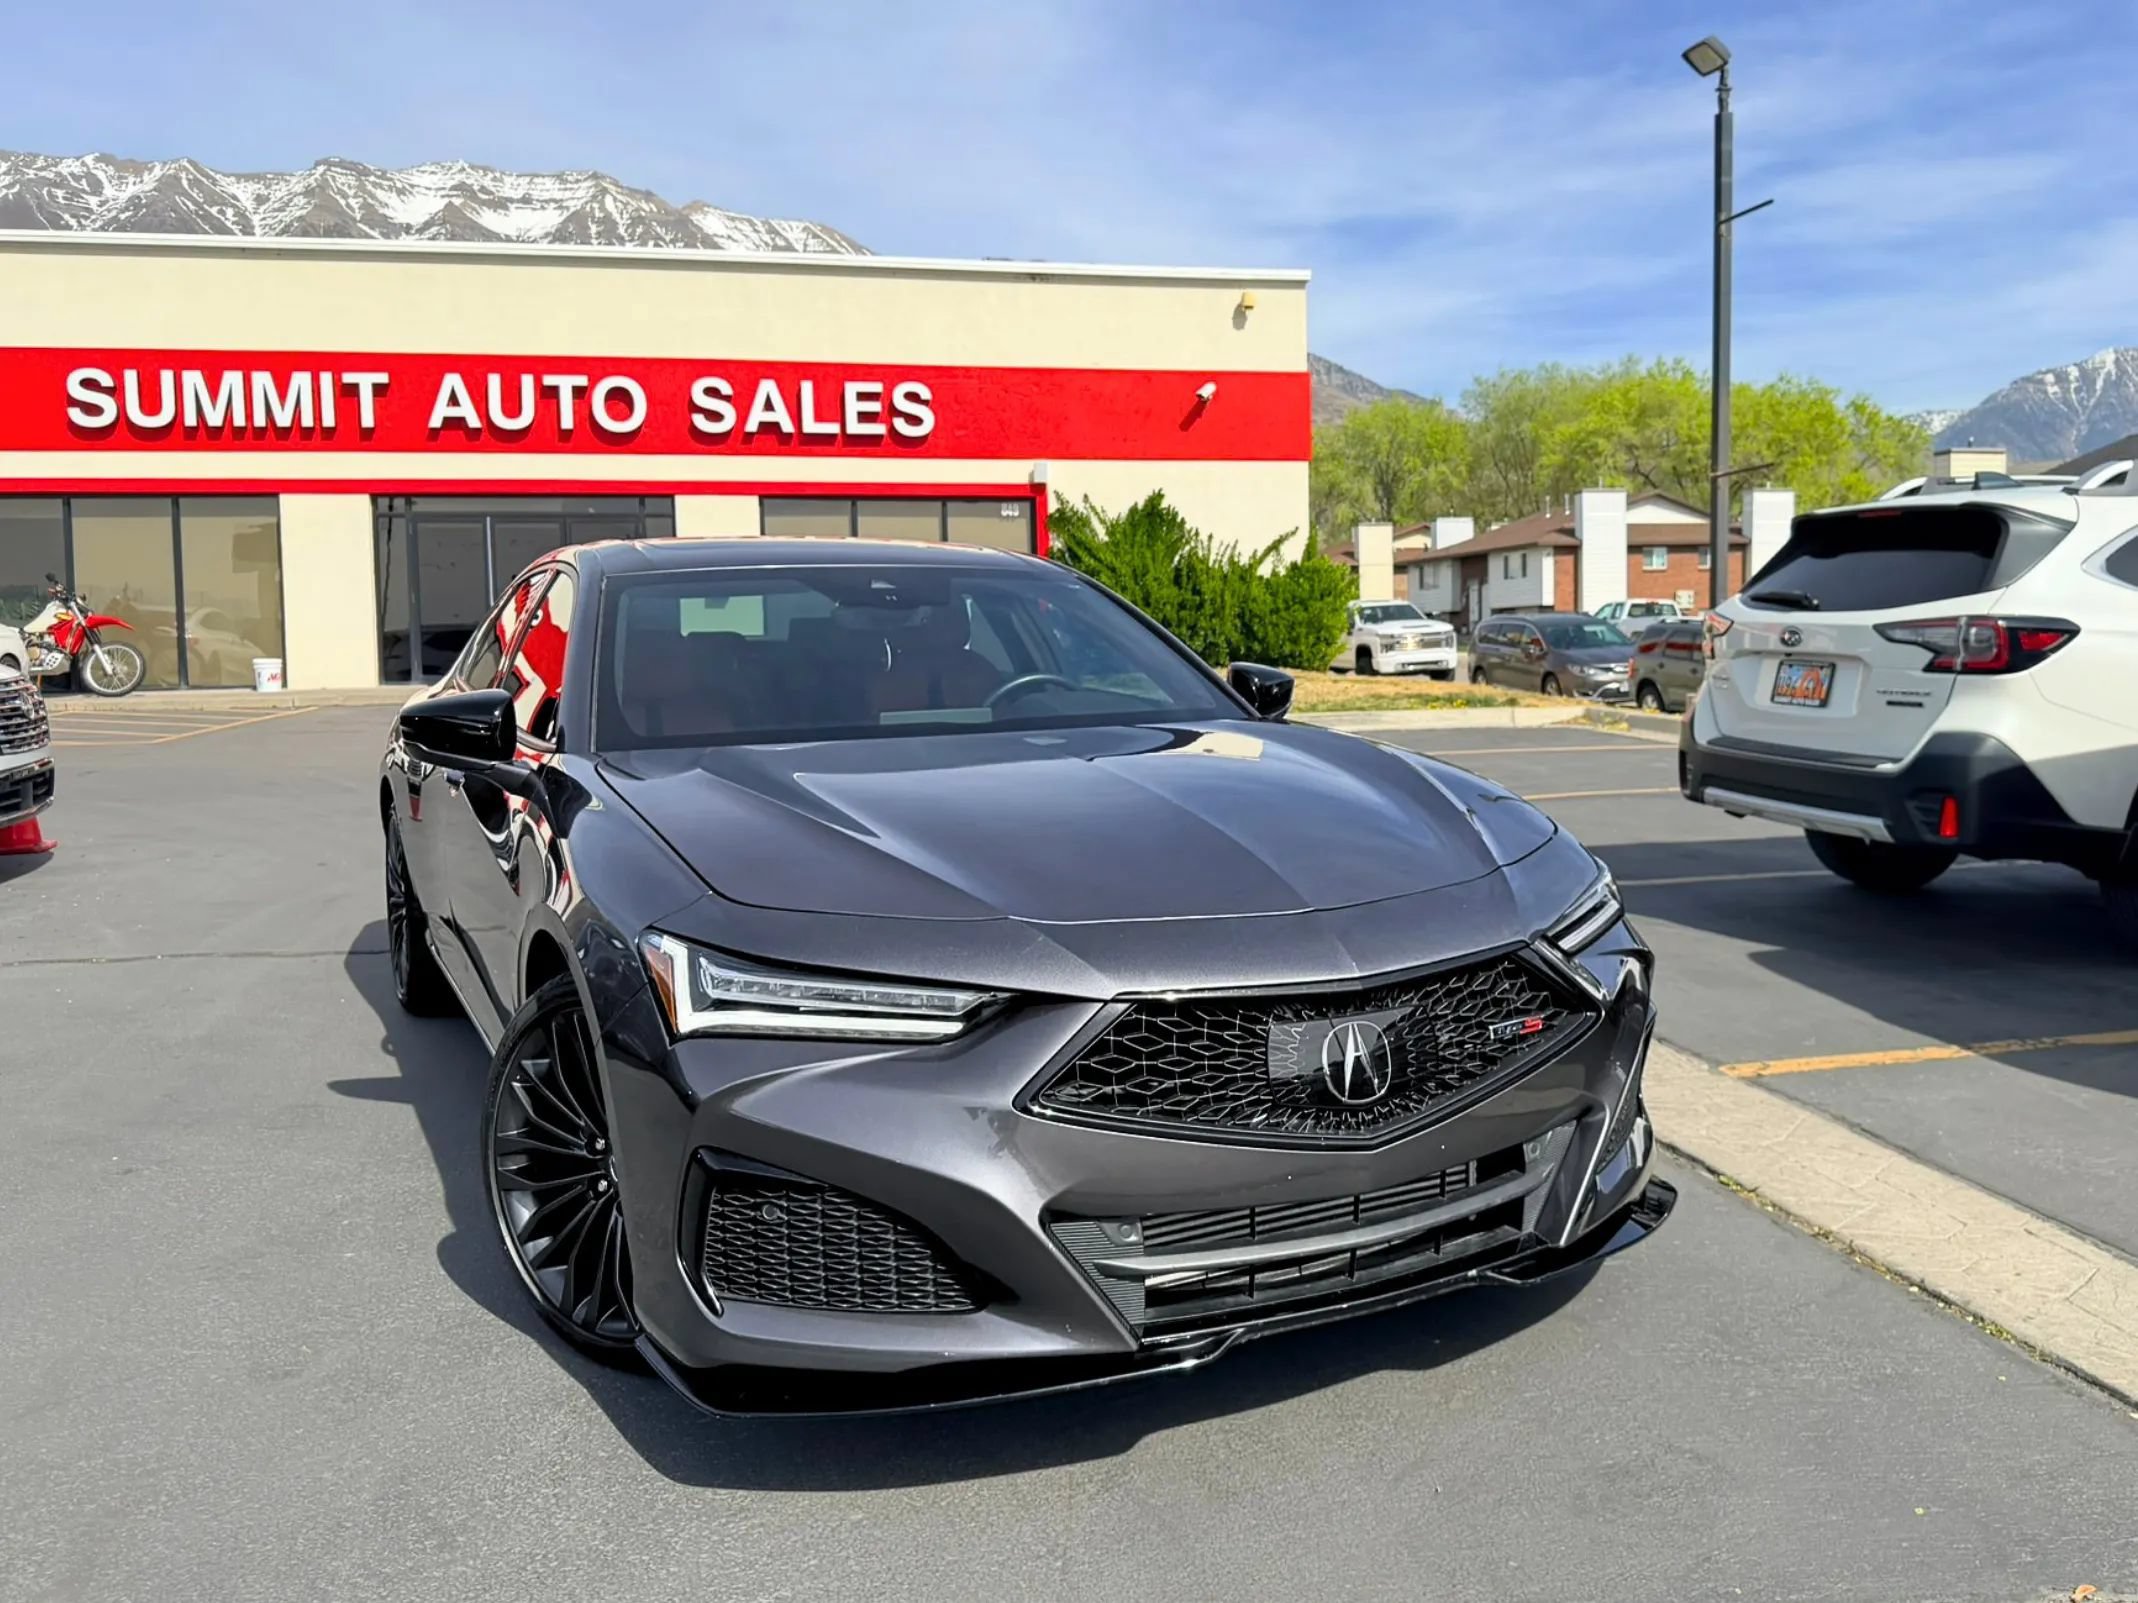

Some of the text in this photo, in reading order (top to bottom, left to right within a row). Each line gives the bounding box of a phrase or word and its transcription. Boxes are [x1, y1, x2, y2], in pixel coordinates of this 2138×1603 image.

[66, 367, 935, 437] SUMMIT AUTO SALES
